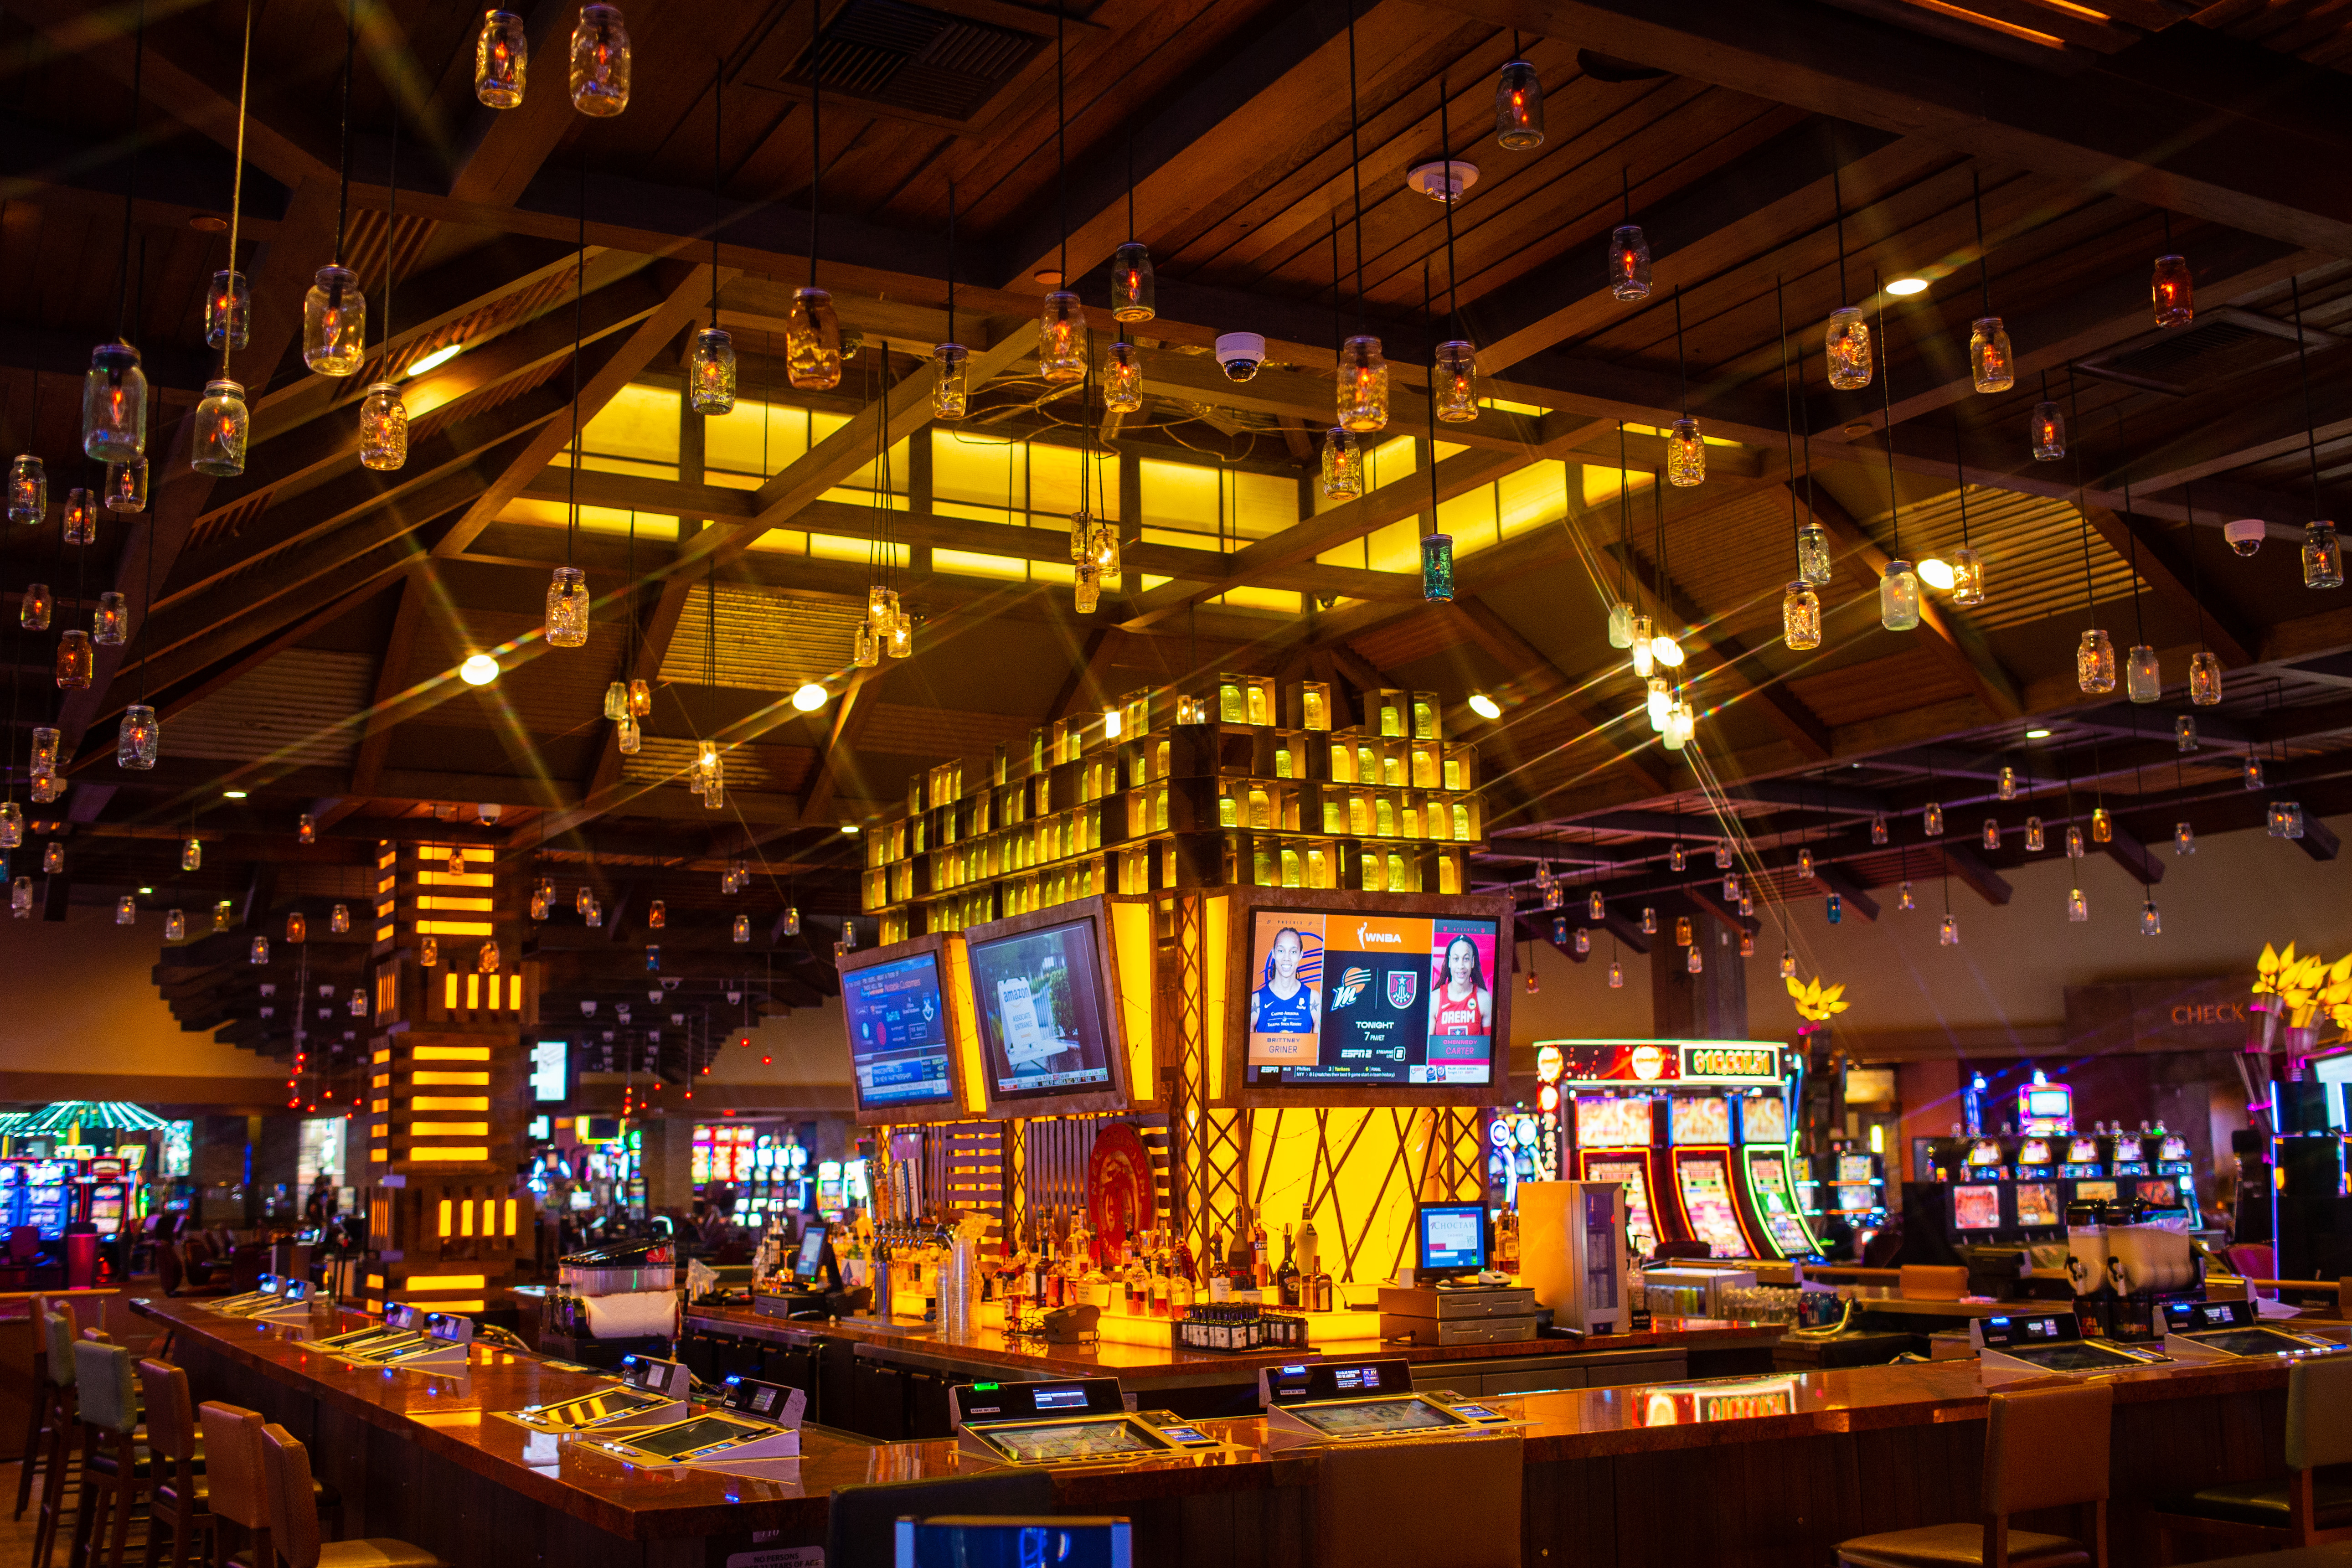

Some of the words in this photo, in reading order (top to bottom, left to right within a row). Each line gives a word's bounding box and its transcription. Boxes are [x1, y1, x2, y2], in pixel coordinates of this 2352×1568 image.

[1365, 933, 1402, 943] WNBA
[1003, 987, 1030, 1002] amazon
[1441, 1010, 1475, 1025] DREAM
[2171, 1002, 2246, 1024] CHECK
[1355, 1021, 1395, 1029] TONIGHT
[1364, 1031, 1371, 1041] 7
[1445, 1047, 1474, 1055] CARTER
[1434, 1221, 1475, 1229] CHOCTAW
[766, 1553, 799, 1562] PERSONS
